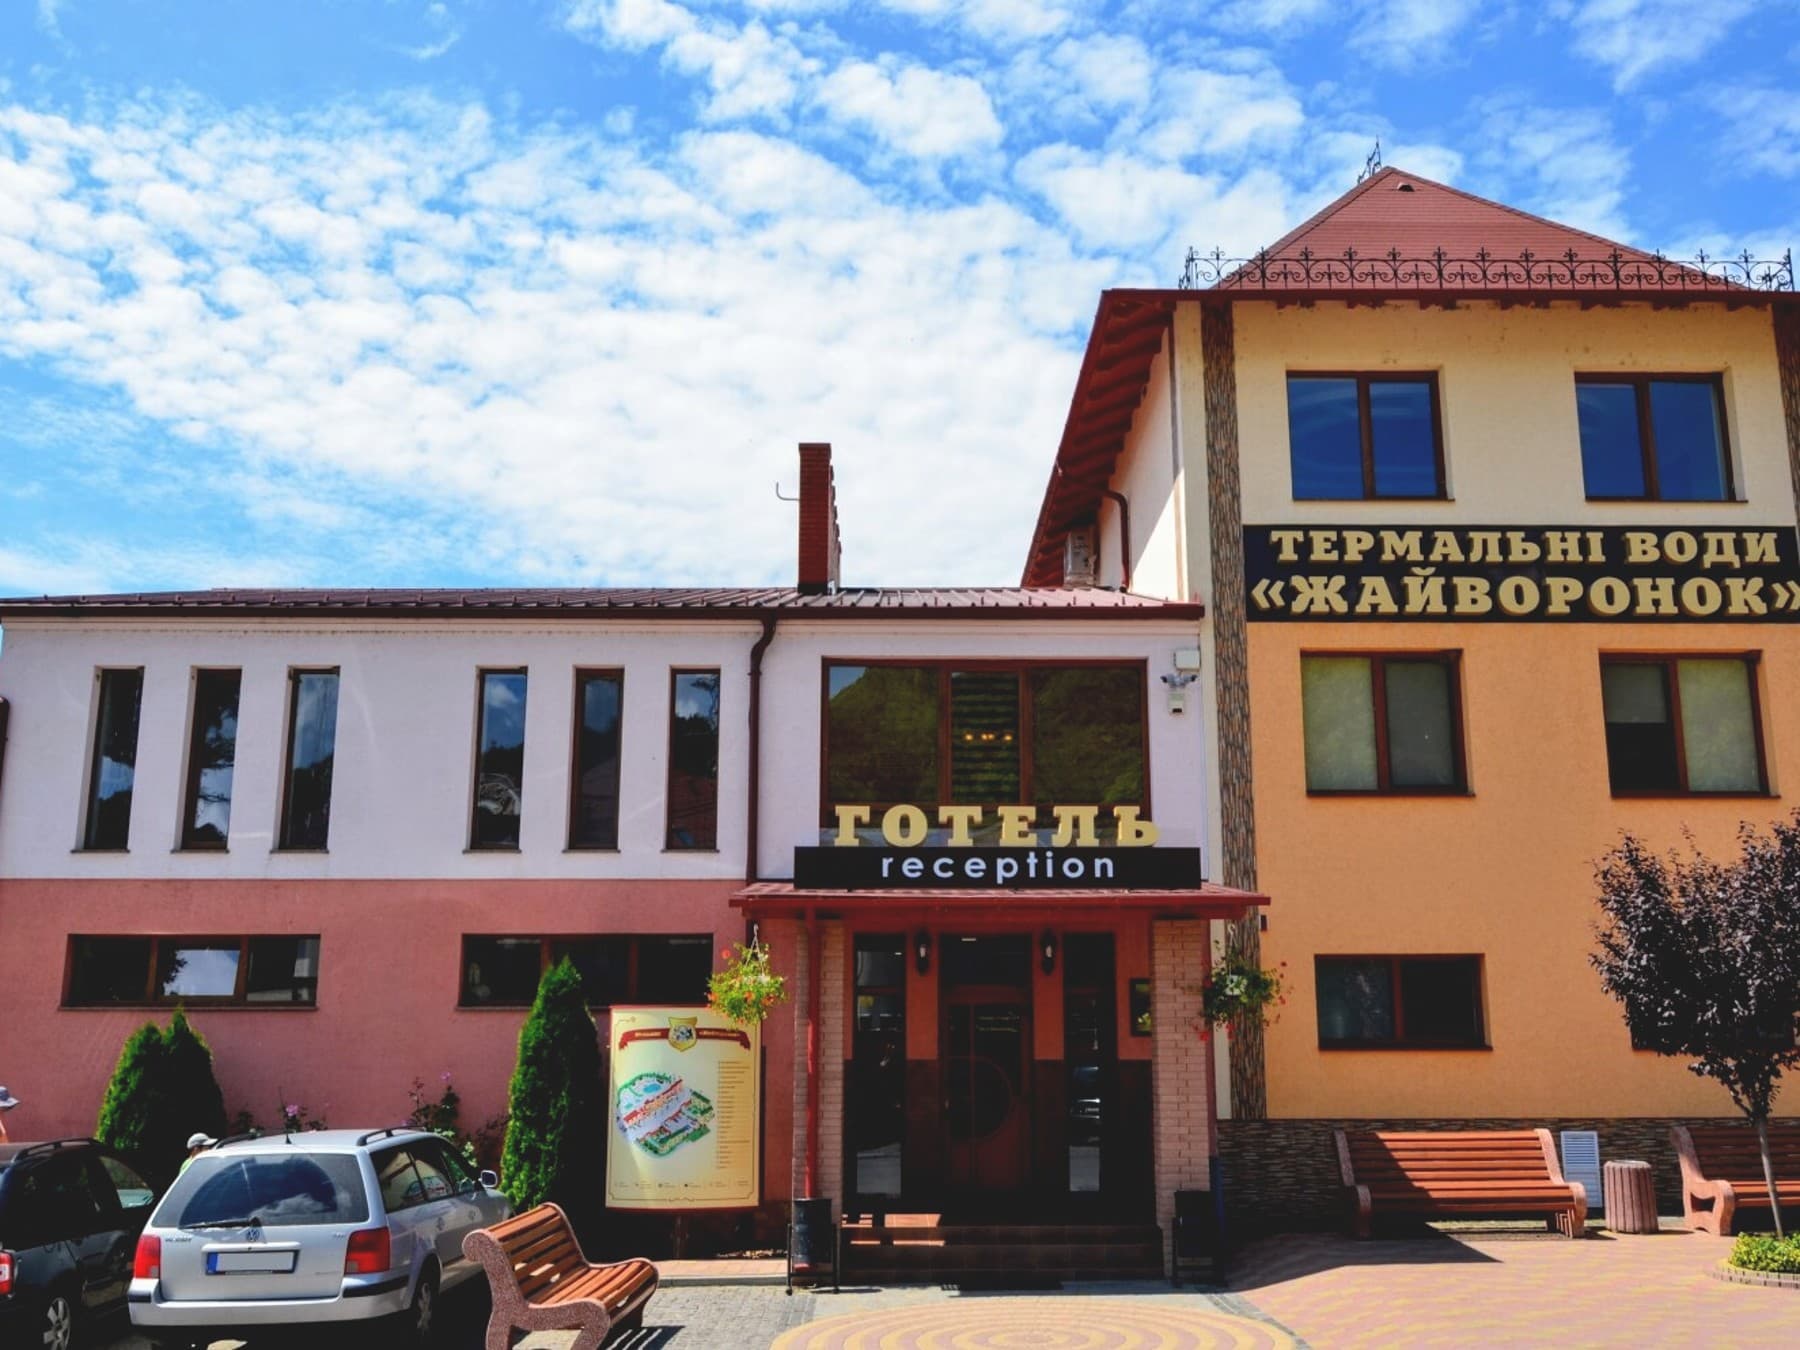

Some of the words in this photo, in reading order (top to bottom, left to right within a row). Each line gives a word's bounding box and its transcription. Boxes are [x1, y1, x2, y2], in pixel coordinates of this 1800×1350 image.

[1270, 530, 1606, 564] ТЕРМАЛЬНІ
[1623, 530, 1781, 569] ВОДИ
[834, 804, 1161, 848] ГОТЕЛЬ
[881, 852, 1115, 884] reception
